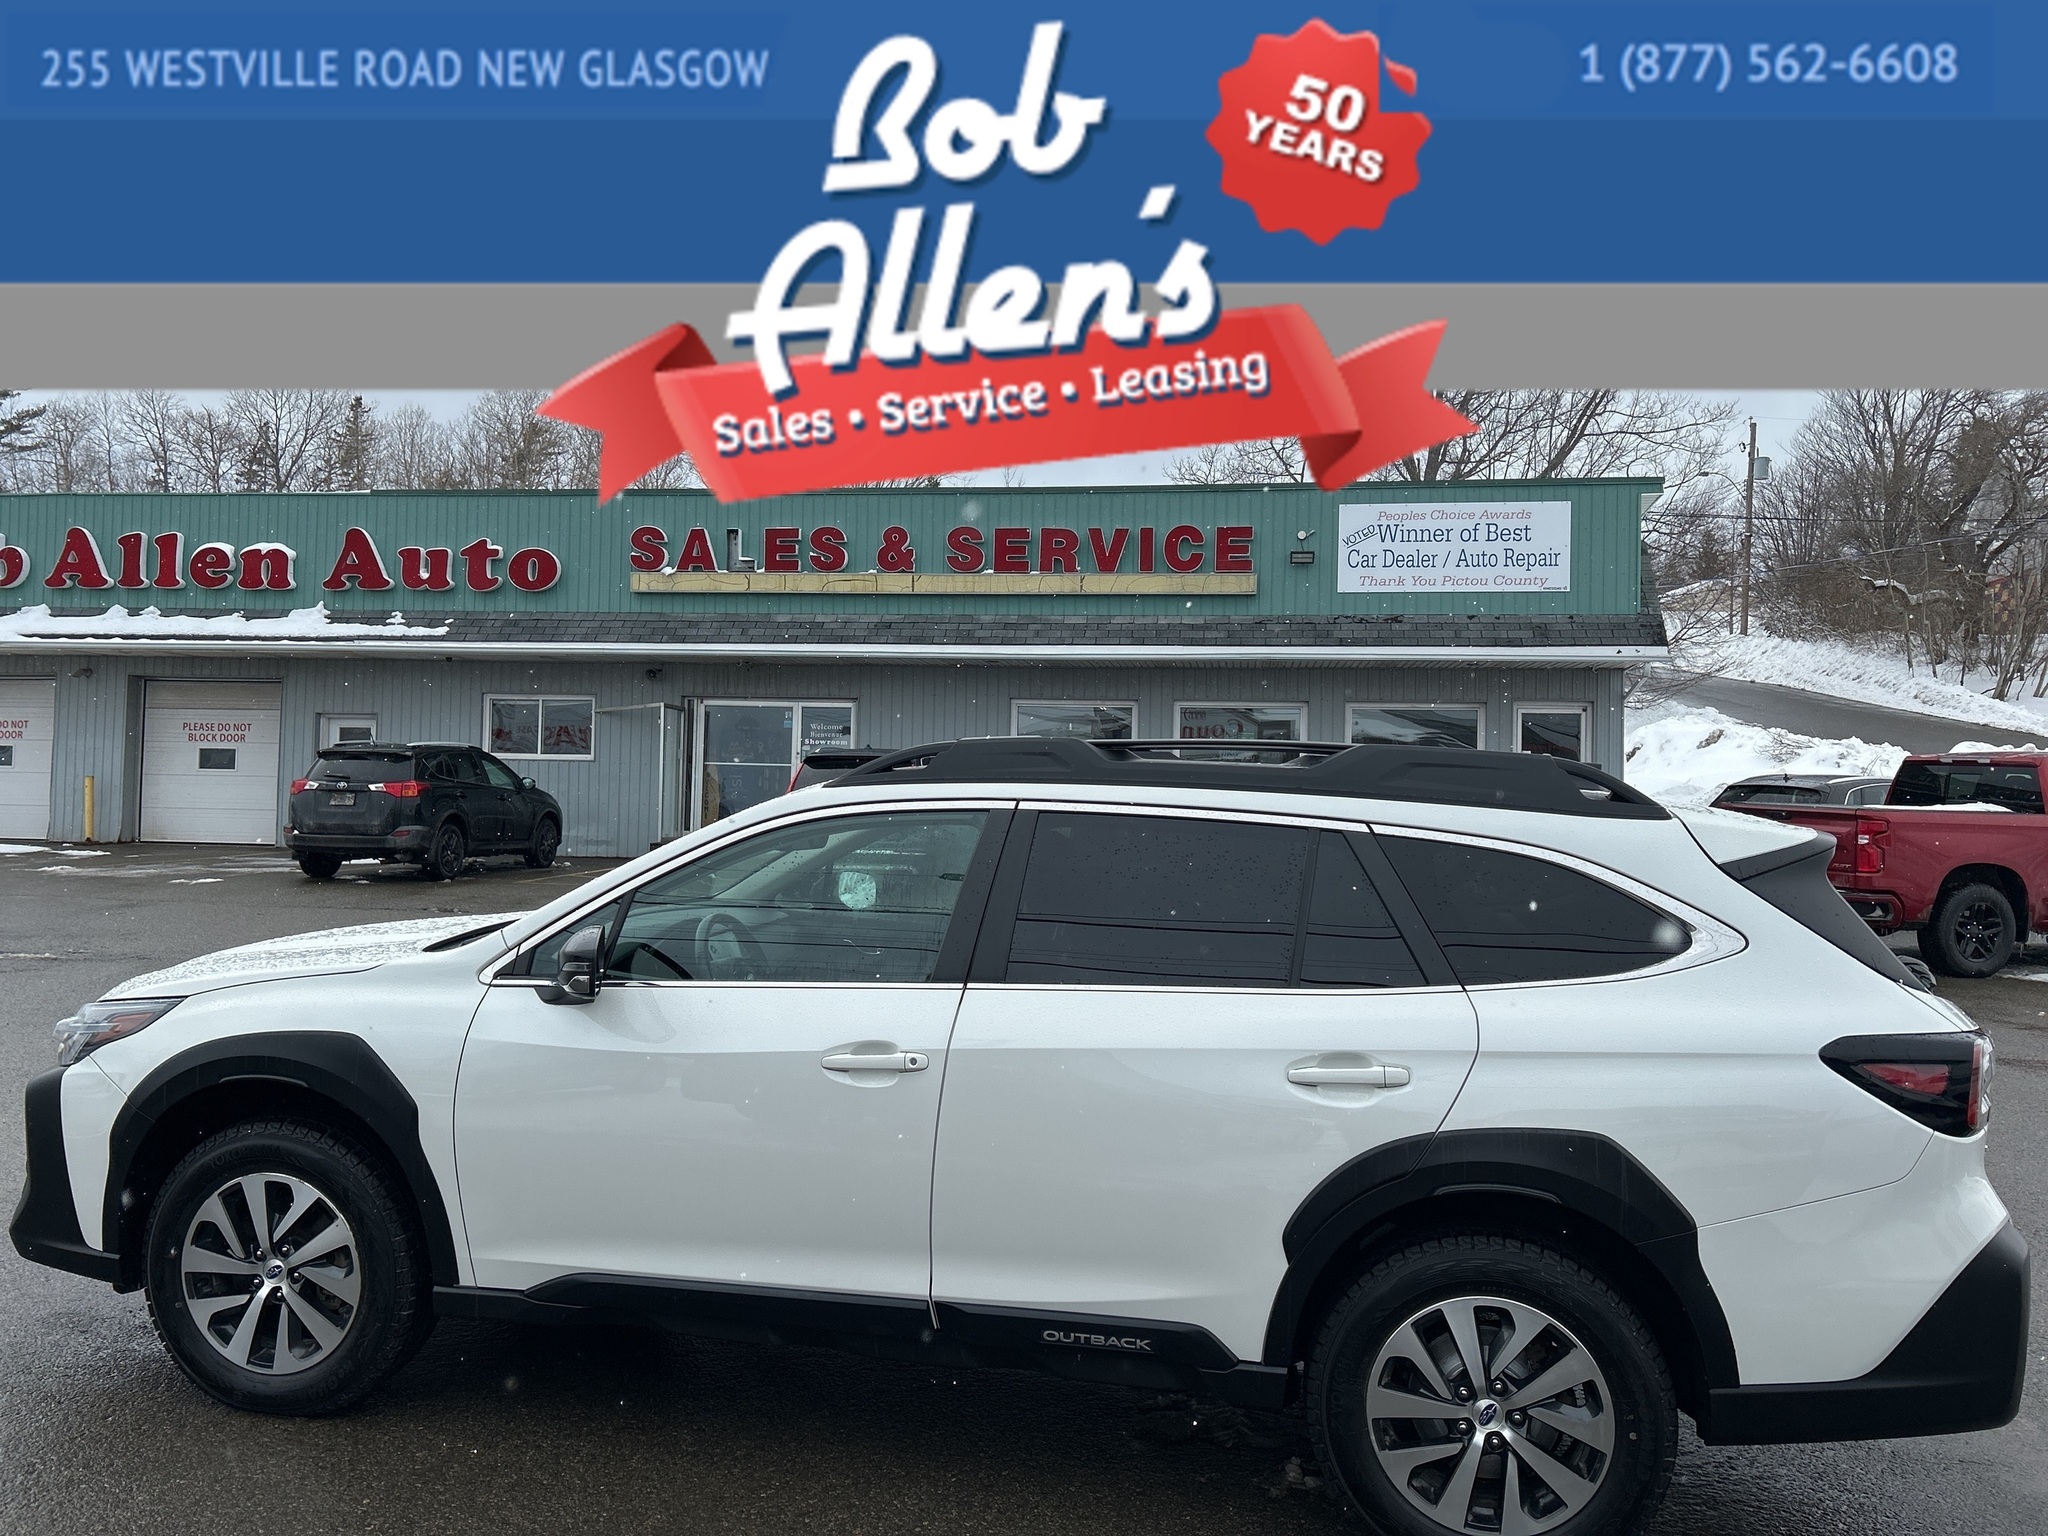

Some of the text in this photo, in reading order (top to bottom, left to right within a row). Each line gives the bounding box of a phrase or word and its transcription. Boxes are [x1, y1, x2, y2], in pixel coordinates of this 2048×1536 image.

[1377, 509, 1532, 522] Peoples Choice Awards
[1341, 524, 1377, 547] VOTED
[1377, 522, 1532, 543] Winner of Best
[630, 525, 1254, 573] SALES & SERVICE
[43, 526, 296, 591] Allen
[322, 526, 562, 592] Auto
[1347, 547, 1561, 572] Car Dealer / Auto Repair
[1359, 575, 1406, 587] Thank
[1411, 575, 1437, 587] You
[1441, 575, 1489, 586] Pictou
[1493, 574, 1549, 588] County
[10, 720, 29, 729] NOT
[182, 722, 252, 732] PLEASE DO NOT
[188, 732, 246, 743] BLOCK DOOR
[810, 730, 843, 738] Bienvenue
[1042, 1329, 1152, 1351] OUTBACK
